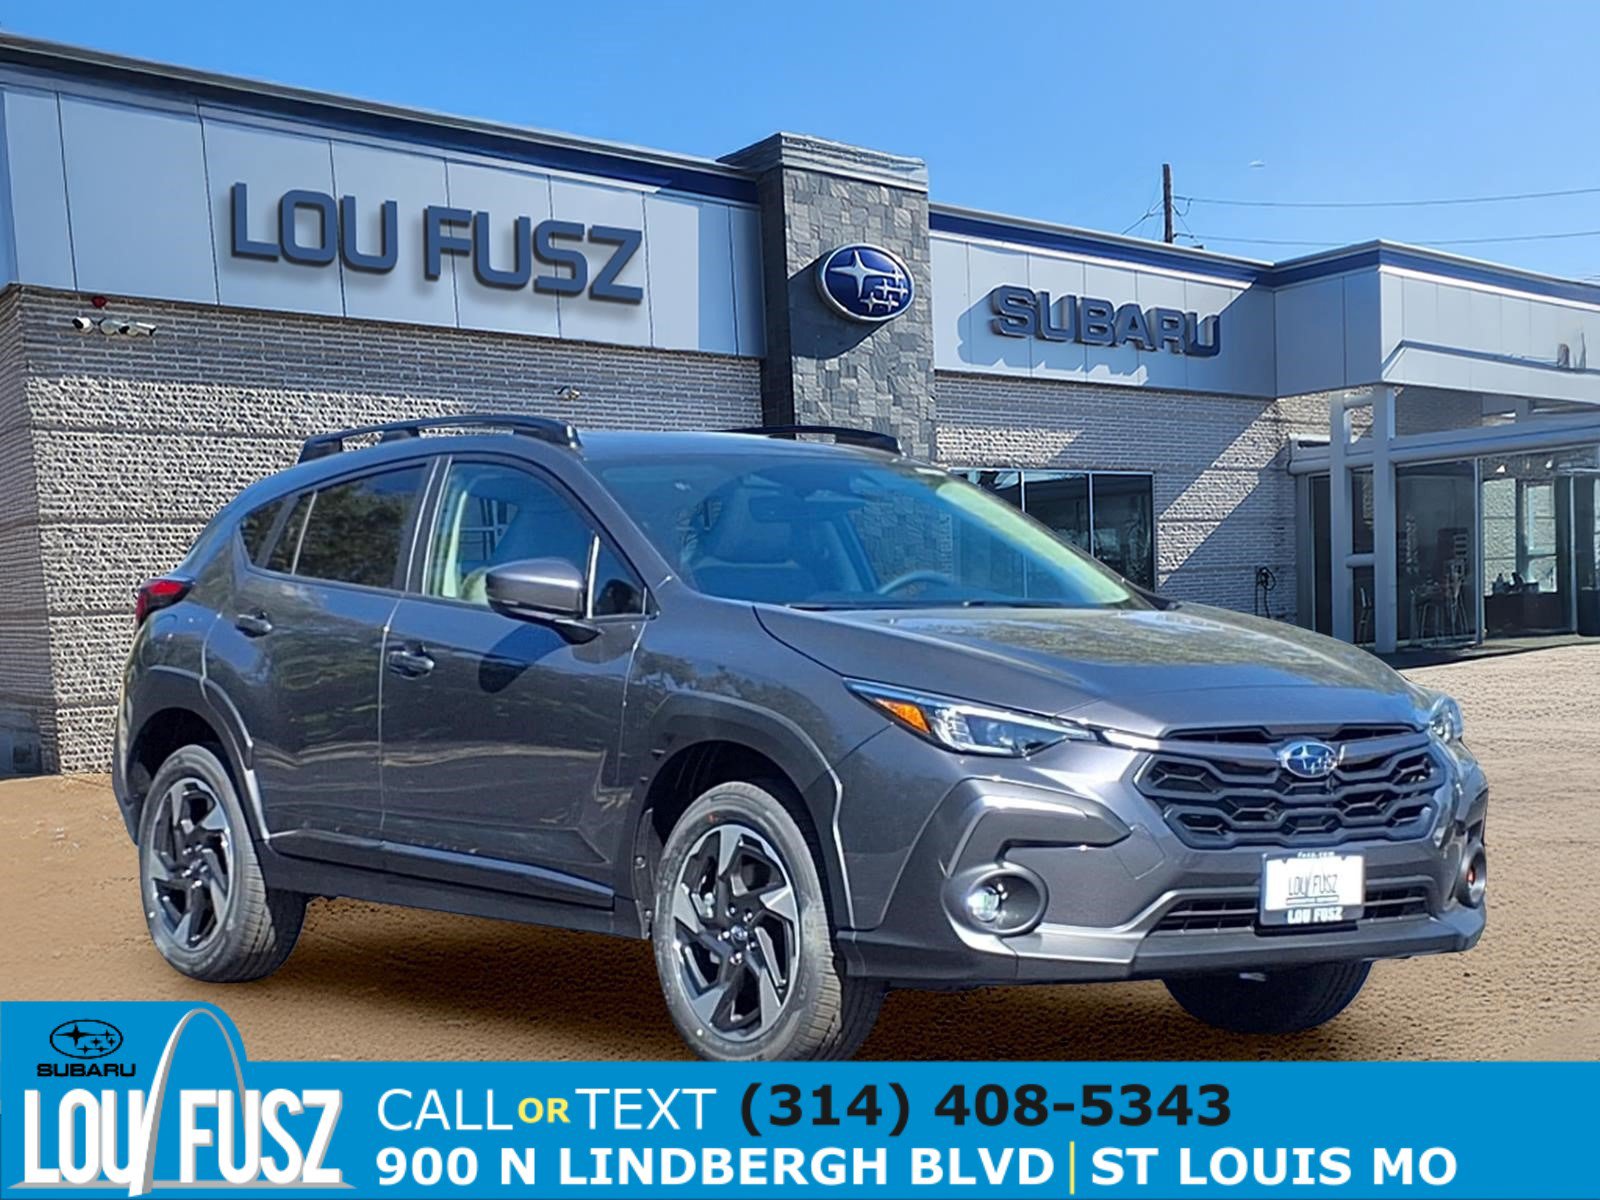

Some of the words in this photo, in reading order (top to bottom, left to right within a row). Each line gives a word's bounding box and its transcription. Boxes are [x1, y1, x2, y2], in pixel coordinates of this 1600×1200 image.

[232, 181, 397, 272] LOU
[424, 204, 643, 305] FUSZ
[990, 284, 1221, 357] SUBARU
[1288, 876, 1308, 896] LOU
[1313, 873, 1338, 895] FUSZ
[1287, 909, 1311, 924] LOU
[1313, 906, 1343, 922] FUSZ
